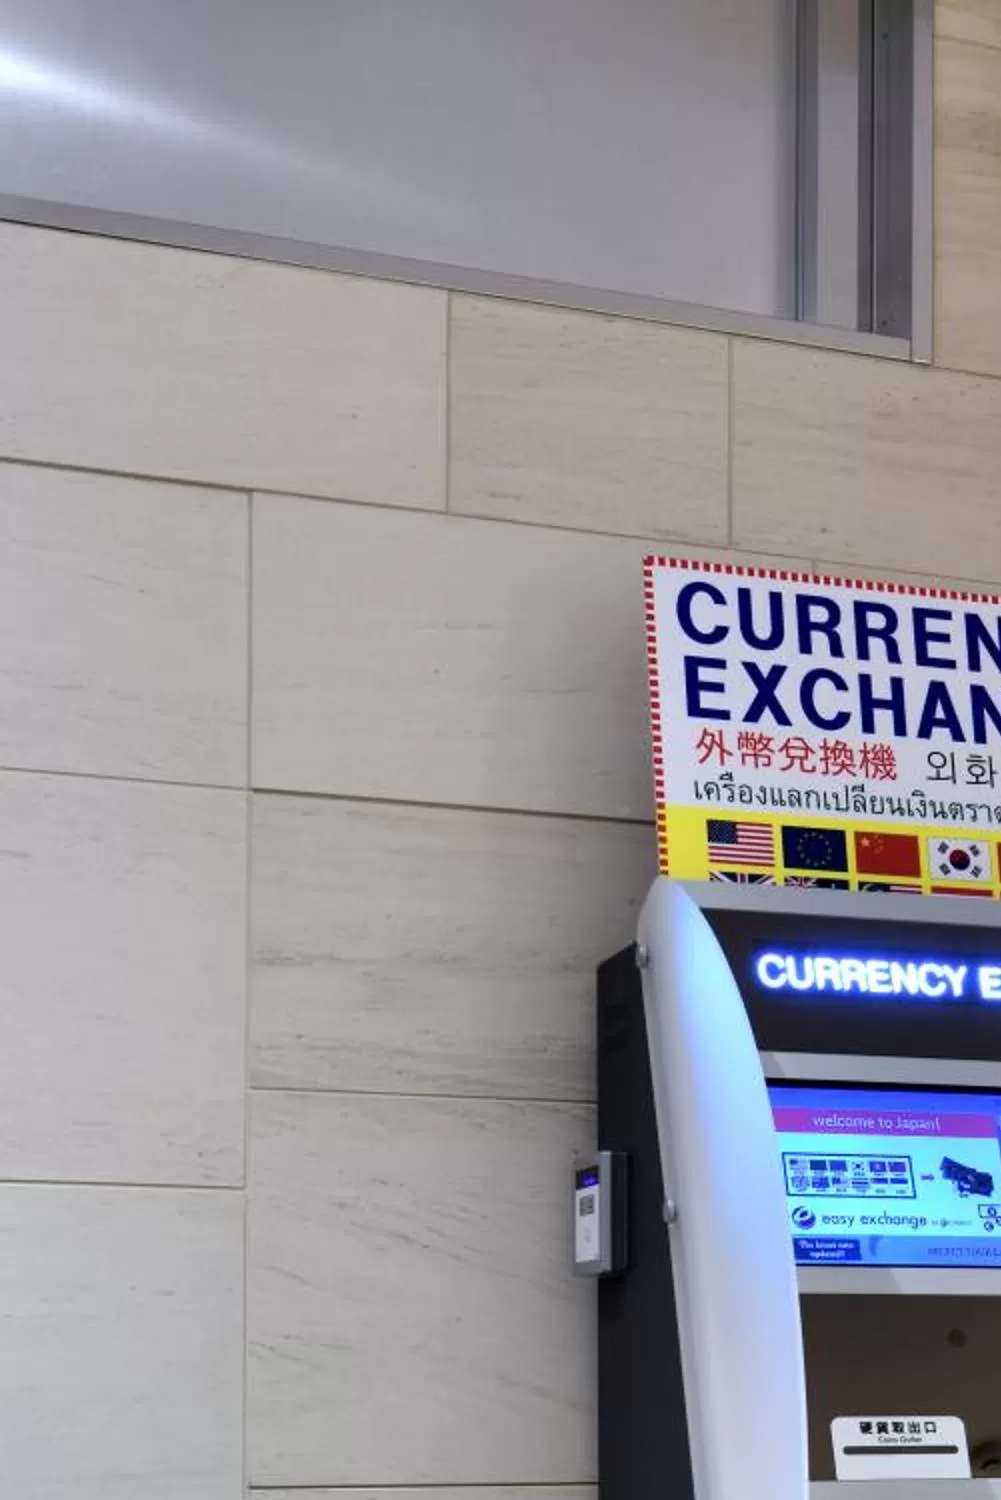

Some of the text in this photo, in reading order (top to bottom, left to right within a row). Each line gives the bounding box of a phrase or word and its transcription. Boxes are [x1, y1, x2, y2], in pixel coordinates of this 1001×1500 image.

[696, 727, 898, 781] 外幣兌換機
[926, 750, 998, 789] 외화
[755, 952, 967, 998] CURRENCY
[812, 1113, 875, 1128] welcome
[879, 1117, 893, 1128] to
[821, 1210, 928, 1230] easy exchange
